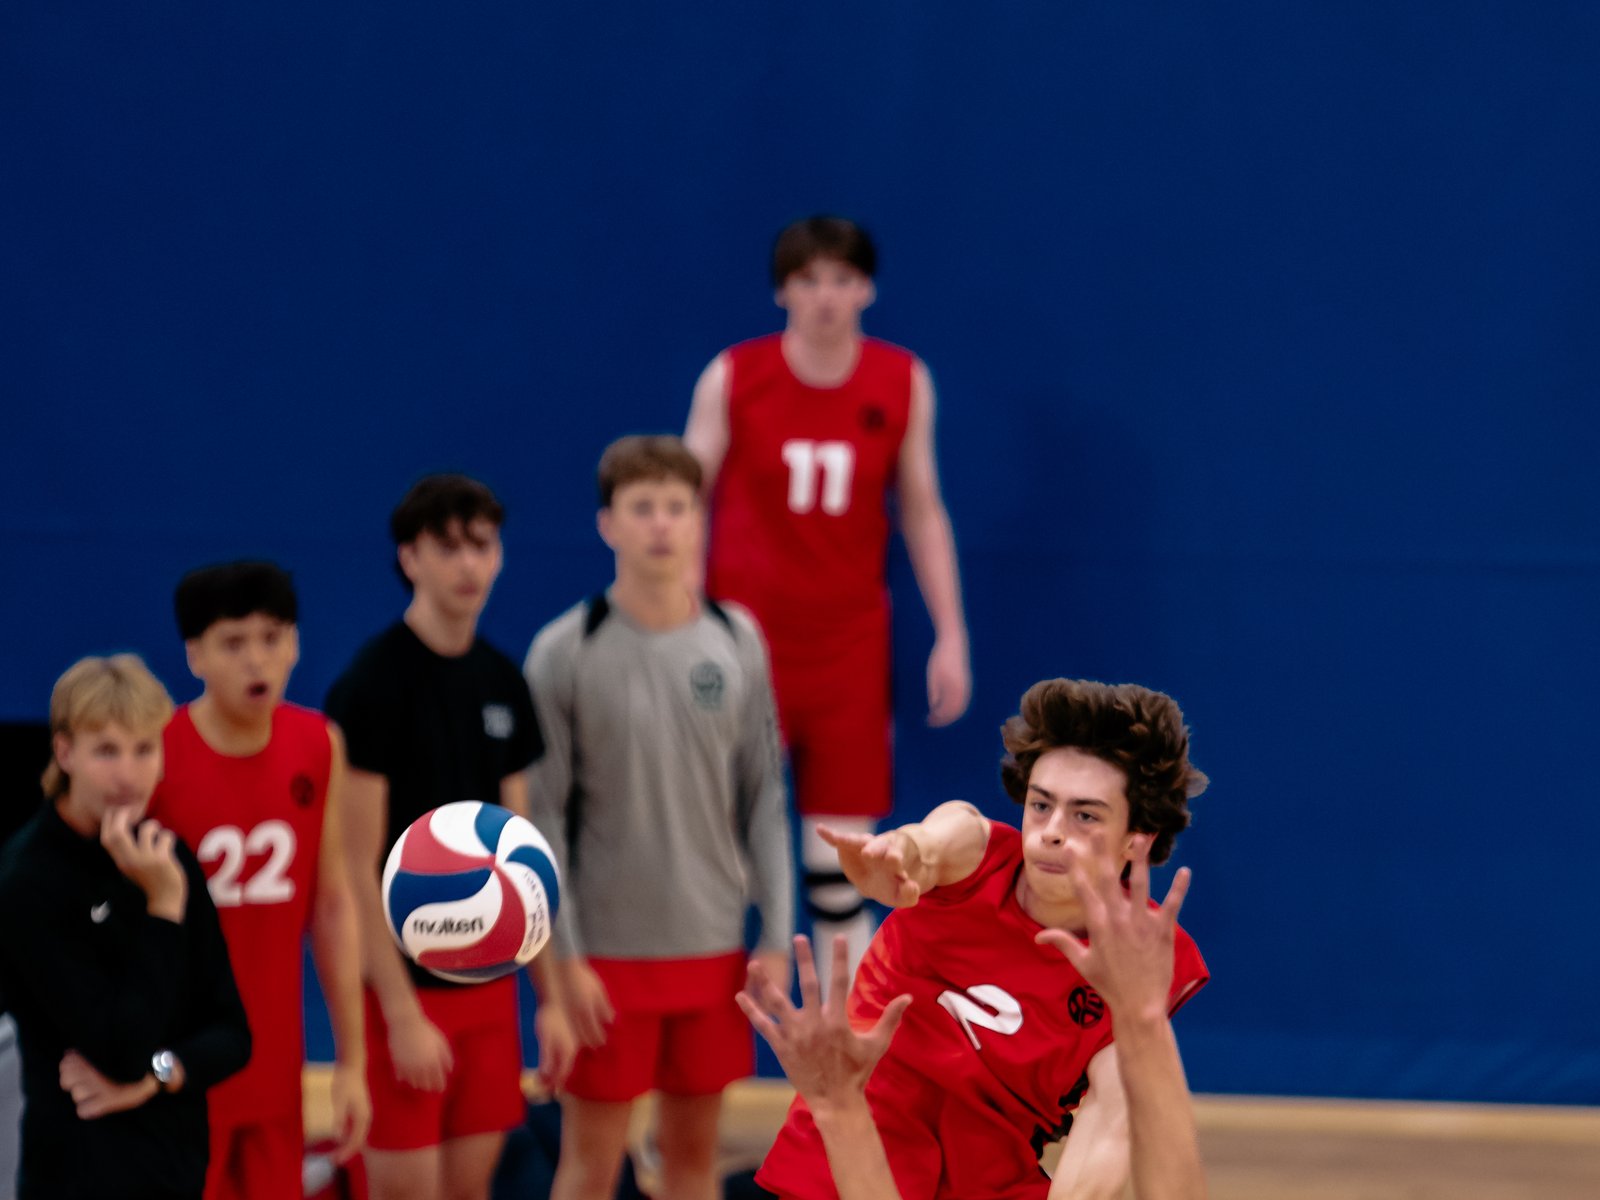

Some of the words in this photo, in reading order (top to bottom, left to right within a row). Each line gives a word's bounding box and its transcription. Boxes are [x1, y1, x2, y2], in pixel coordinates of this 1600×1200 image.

[781, 438, 855, 516] 11
[197, 819, 297, 907] 22
[412, 916, 484, 937] molten
[937, 984, 1024, 1050] 2
